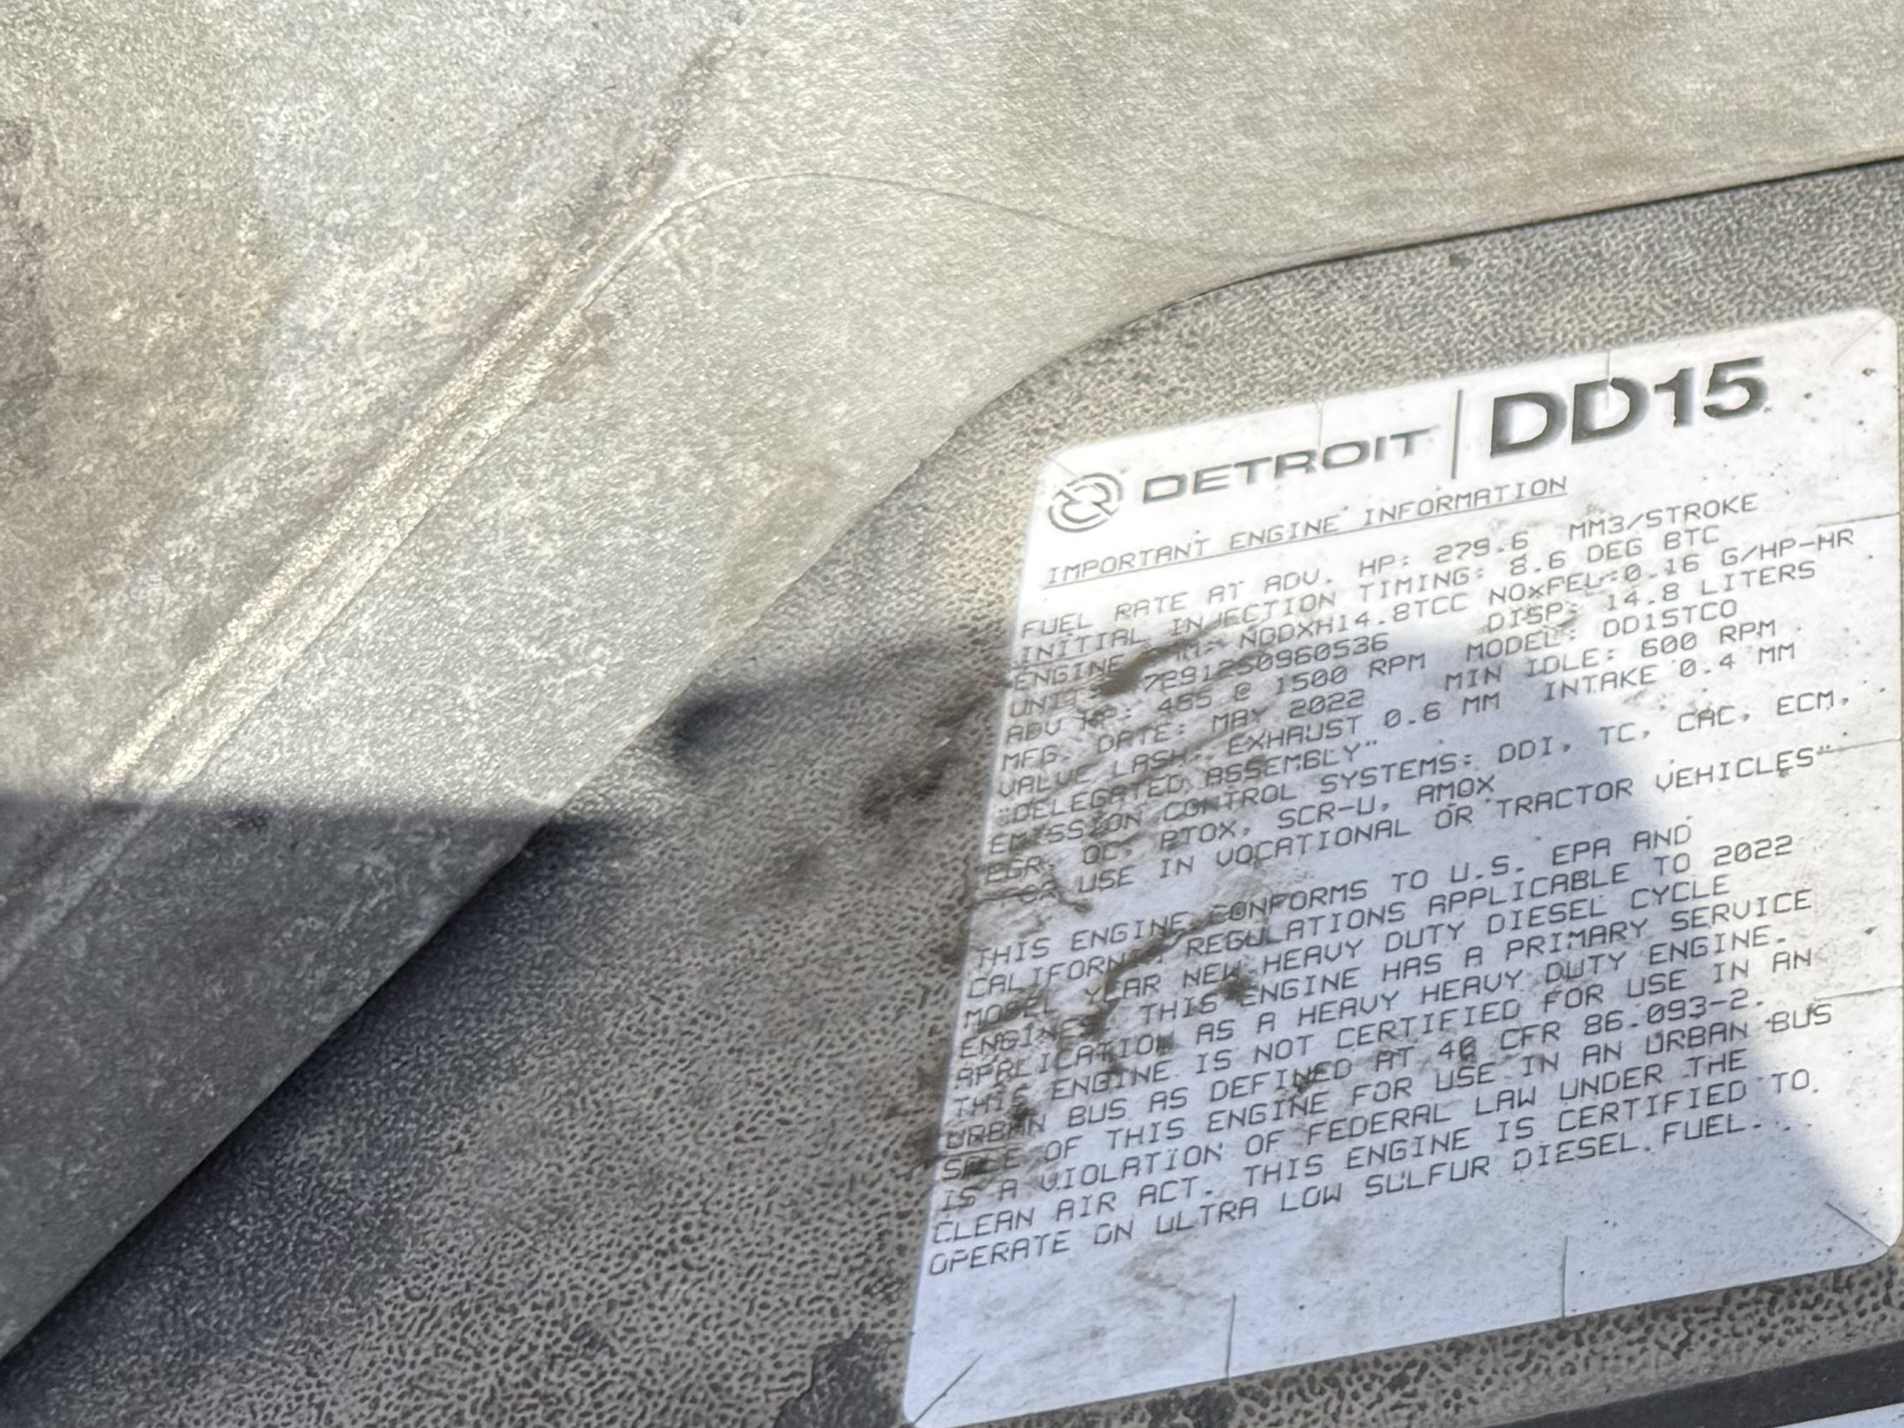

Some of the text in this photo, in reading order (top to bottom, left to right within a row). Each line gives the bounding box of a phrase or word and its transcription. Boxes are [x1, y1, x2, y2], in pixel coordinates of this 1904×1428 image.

[1141, 351, 1769, 504] DETROIT DD15
[1021, 490, 1759, 641] FUEL RATE AT ADV. HP: 279.6 MM3/STROKE
[1046, 473, 1567, 585] IMPORTANT ENGINE INFORMATION
[1357, 564, 1484, 606] TIMING:
[1510, 549, 1566, 579] 8.6
[1587, 536, 1643, 565] DEG
[1665, 522, 1720, 552] BTC
[1722, 524, 1856, 568] G/HP-HR
[1607, 581, 1680, 614] 14.8
[1702, 557, 1817, 597] LITERS
[1275, 665, 1349, 698] 1500
[1369, 651, 1426, 681] RPM
[1289, 616, 1777, 721] 2022 MIN IDLE: 600 RPM
[1384, 701, 1441, 732] 0.6
[1462, 691, 1500, 718] MM
[1544, 663, 1657, 704] INTAKE
[1680, 649, 1737, 680] 0.4
[1760, 639, 1796, 666] MM
[1320, 750, 1471, 797] SYSTEMS:
[1417, 773, 1495, 808] AMOX
[1079, 775, 1633, 894] USE IN VOCATIONAL OR TRACTOR
[1390, 868, 1429, 896] TO
[1451, 851, 1524, 886] U.S.
[1552, 836, 1611, 868] EPA
[1634, 821, 1692, 853] AND
[1429, 861, 1630, 918] APPLICABLE
[1653, 850, 1692, 878] TO
[1715, 832, 1794, 868] 2022
[1264, 871, 1732, 977] HEAVY DUTY DIESEL CYCLE
[1383, 952, 1443, 985] HAS
[1465, 945, 1484, 970] A
[1506, 916, 1649, 963] PRIMARY
[1672, 886, 1814, 934] SERVICE
[1197, 920, 1788, 1047] AS A HEAVY HEAVY DUTY ENGINE.
[1197, 1047, 1234, 1077] IS
[1255, 1033, 1316, 1067] NOT
[1337, 996, 1522, 1052] CERTIFIED
[1545, 982, 1605, 1015] FOR
[1628, 967, 1688, 1000] USE
[1715, 956, 1751, 985] IN
[1775, 944, 1814, 974] AN
[1043, 1000, 1835, 1165] OF THIS ENGINE FOR USE IN AN URBAN BUS
[1068, 1096, 1129, 1130] BUS
[1150, 1085, 1190, 1116] AS
[1501, 1019, 1562, 1053] CFR
[1246, 1128, 1287, 1159] OF
[1309, 1098, 1454, 1148] FEDERAL
[1476, 1084, 1538, 1118] LAW
[1561, 1061, 1664, 1103] UNDER
[1689, 1046, 1749, 1080] THE
[928, 1227, 1073, 1278] OPERATE
[1093, 1216, 1135, 1248] ON
[1156, 1194, 1260, 1237] ULTRA
[1282, 1179, 1344, 1214] LOW
[1366, 1152, 1492, 1199] SULFUR
[1515, 1126, 1641, 1172] DIESEL
[932, 1204, 1036, 1246] CLEAN
[1056, 1189, 1118, 1224] AIR
[1243, 1152, 1326, 1191] THIS
[1348, 1126, 1473, 1172] ENGINE
[1499, 1114, 1536, 1145] IS
[1559, 1076, 1749, 1134] CERTIFIED
[1774, 1065, 1813, 1096] TO
